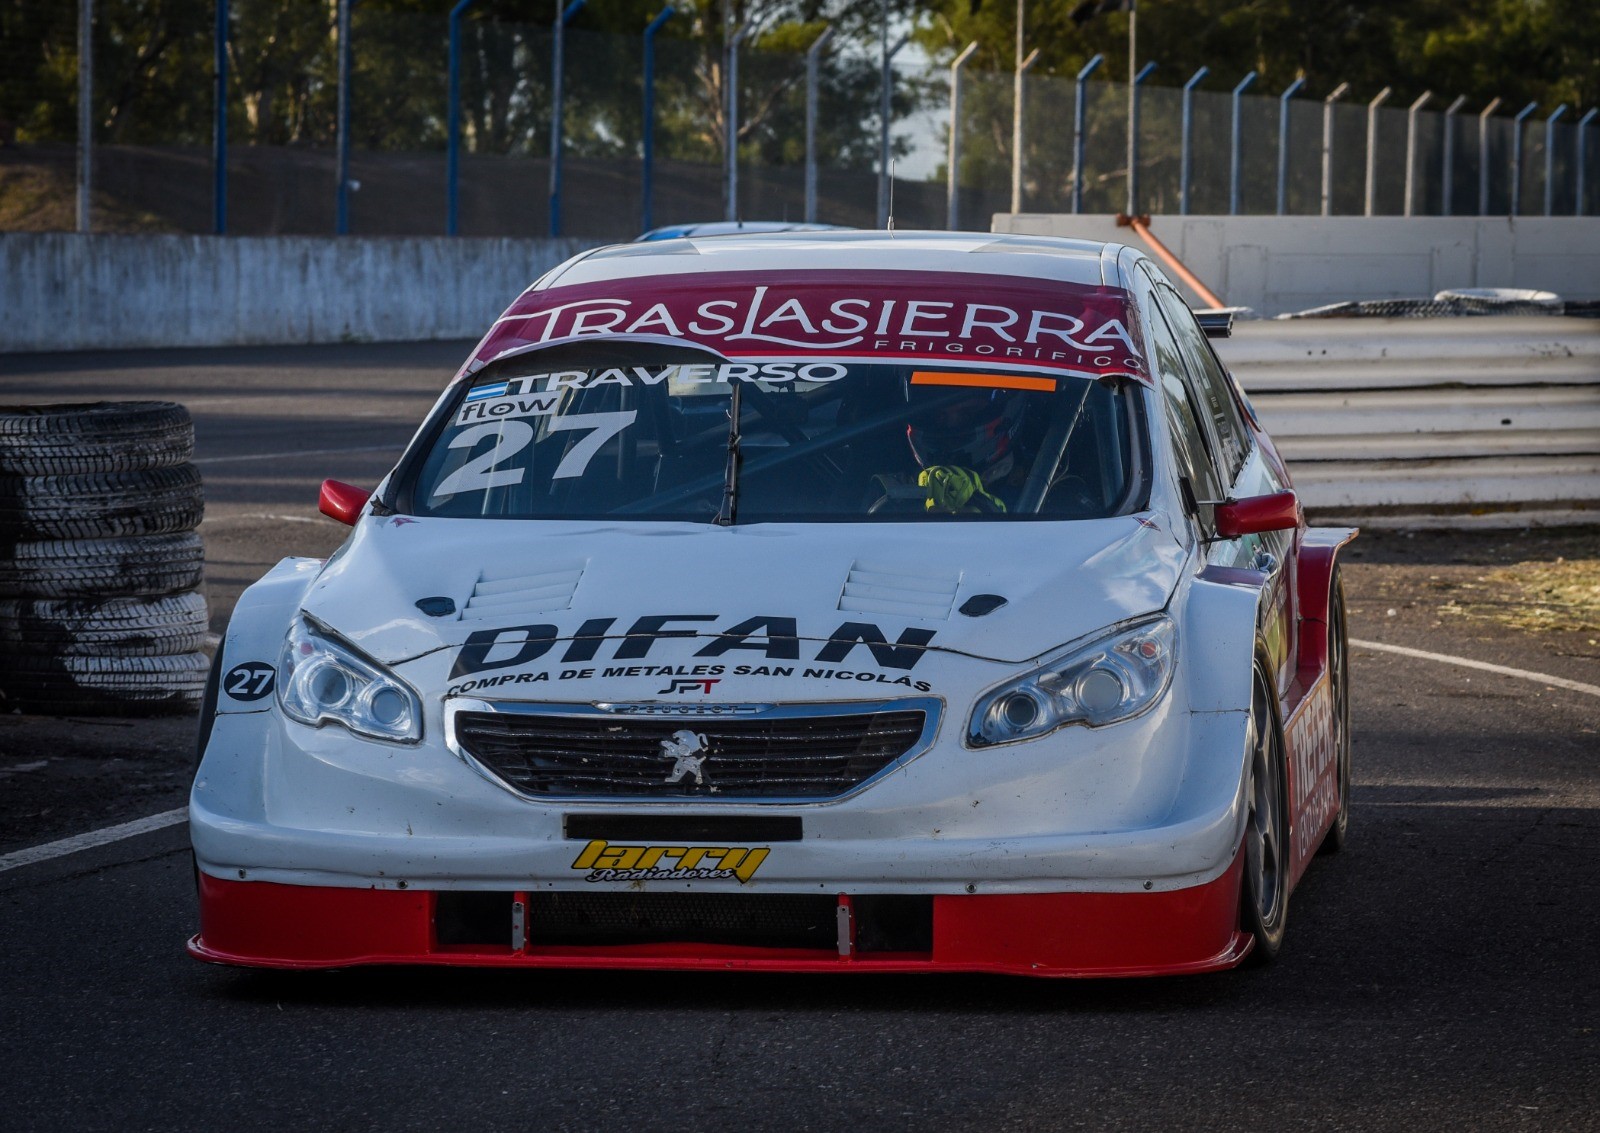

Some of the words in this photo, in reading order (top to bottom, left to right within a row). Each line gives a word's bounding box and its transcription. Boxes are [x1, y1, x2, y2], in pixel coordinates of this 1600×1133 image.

[497, 286, 1143, 357] TRASLASIERRA
[874, 340, 1146, 371] FRIGORÍFICO
[510, 363, 848, 395] TRAVERSO
[462, 397, 557, 422] flow
[433, 409, 638, 497] 27
[447, 614, 938, 682] DIFAN
[228, 668, 275, 695] 27
[446, 671, 550, 698] COMPRA
[559, 668, 596, 681] DE
[602, 665, 726, 678] METALES
[733, 665, 795, 677] SAN
[802, 669, 932, 692] NICOLÁS
[657, 679, 722, 694] JPT
[629, 705, 739, 714] PEUGEOT
[585, 866, 737, 883] Radiadores
